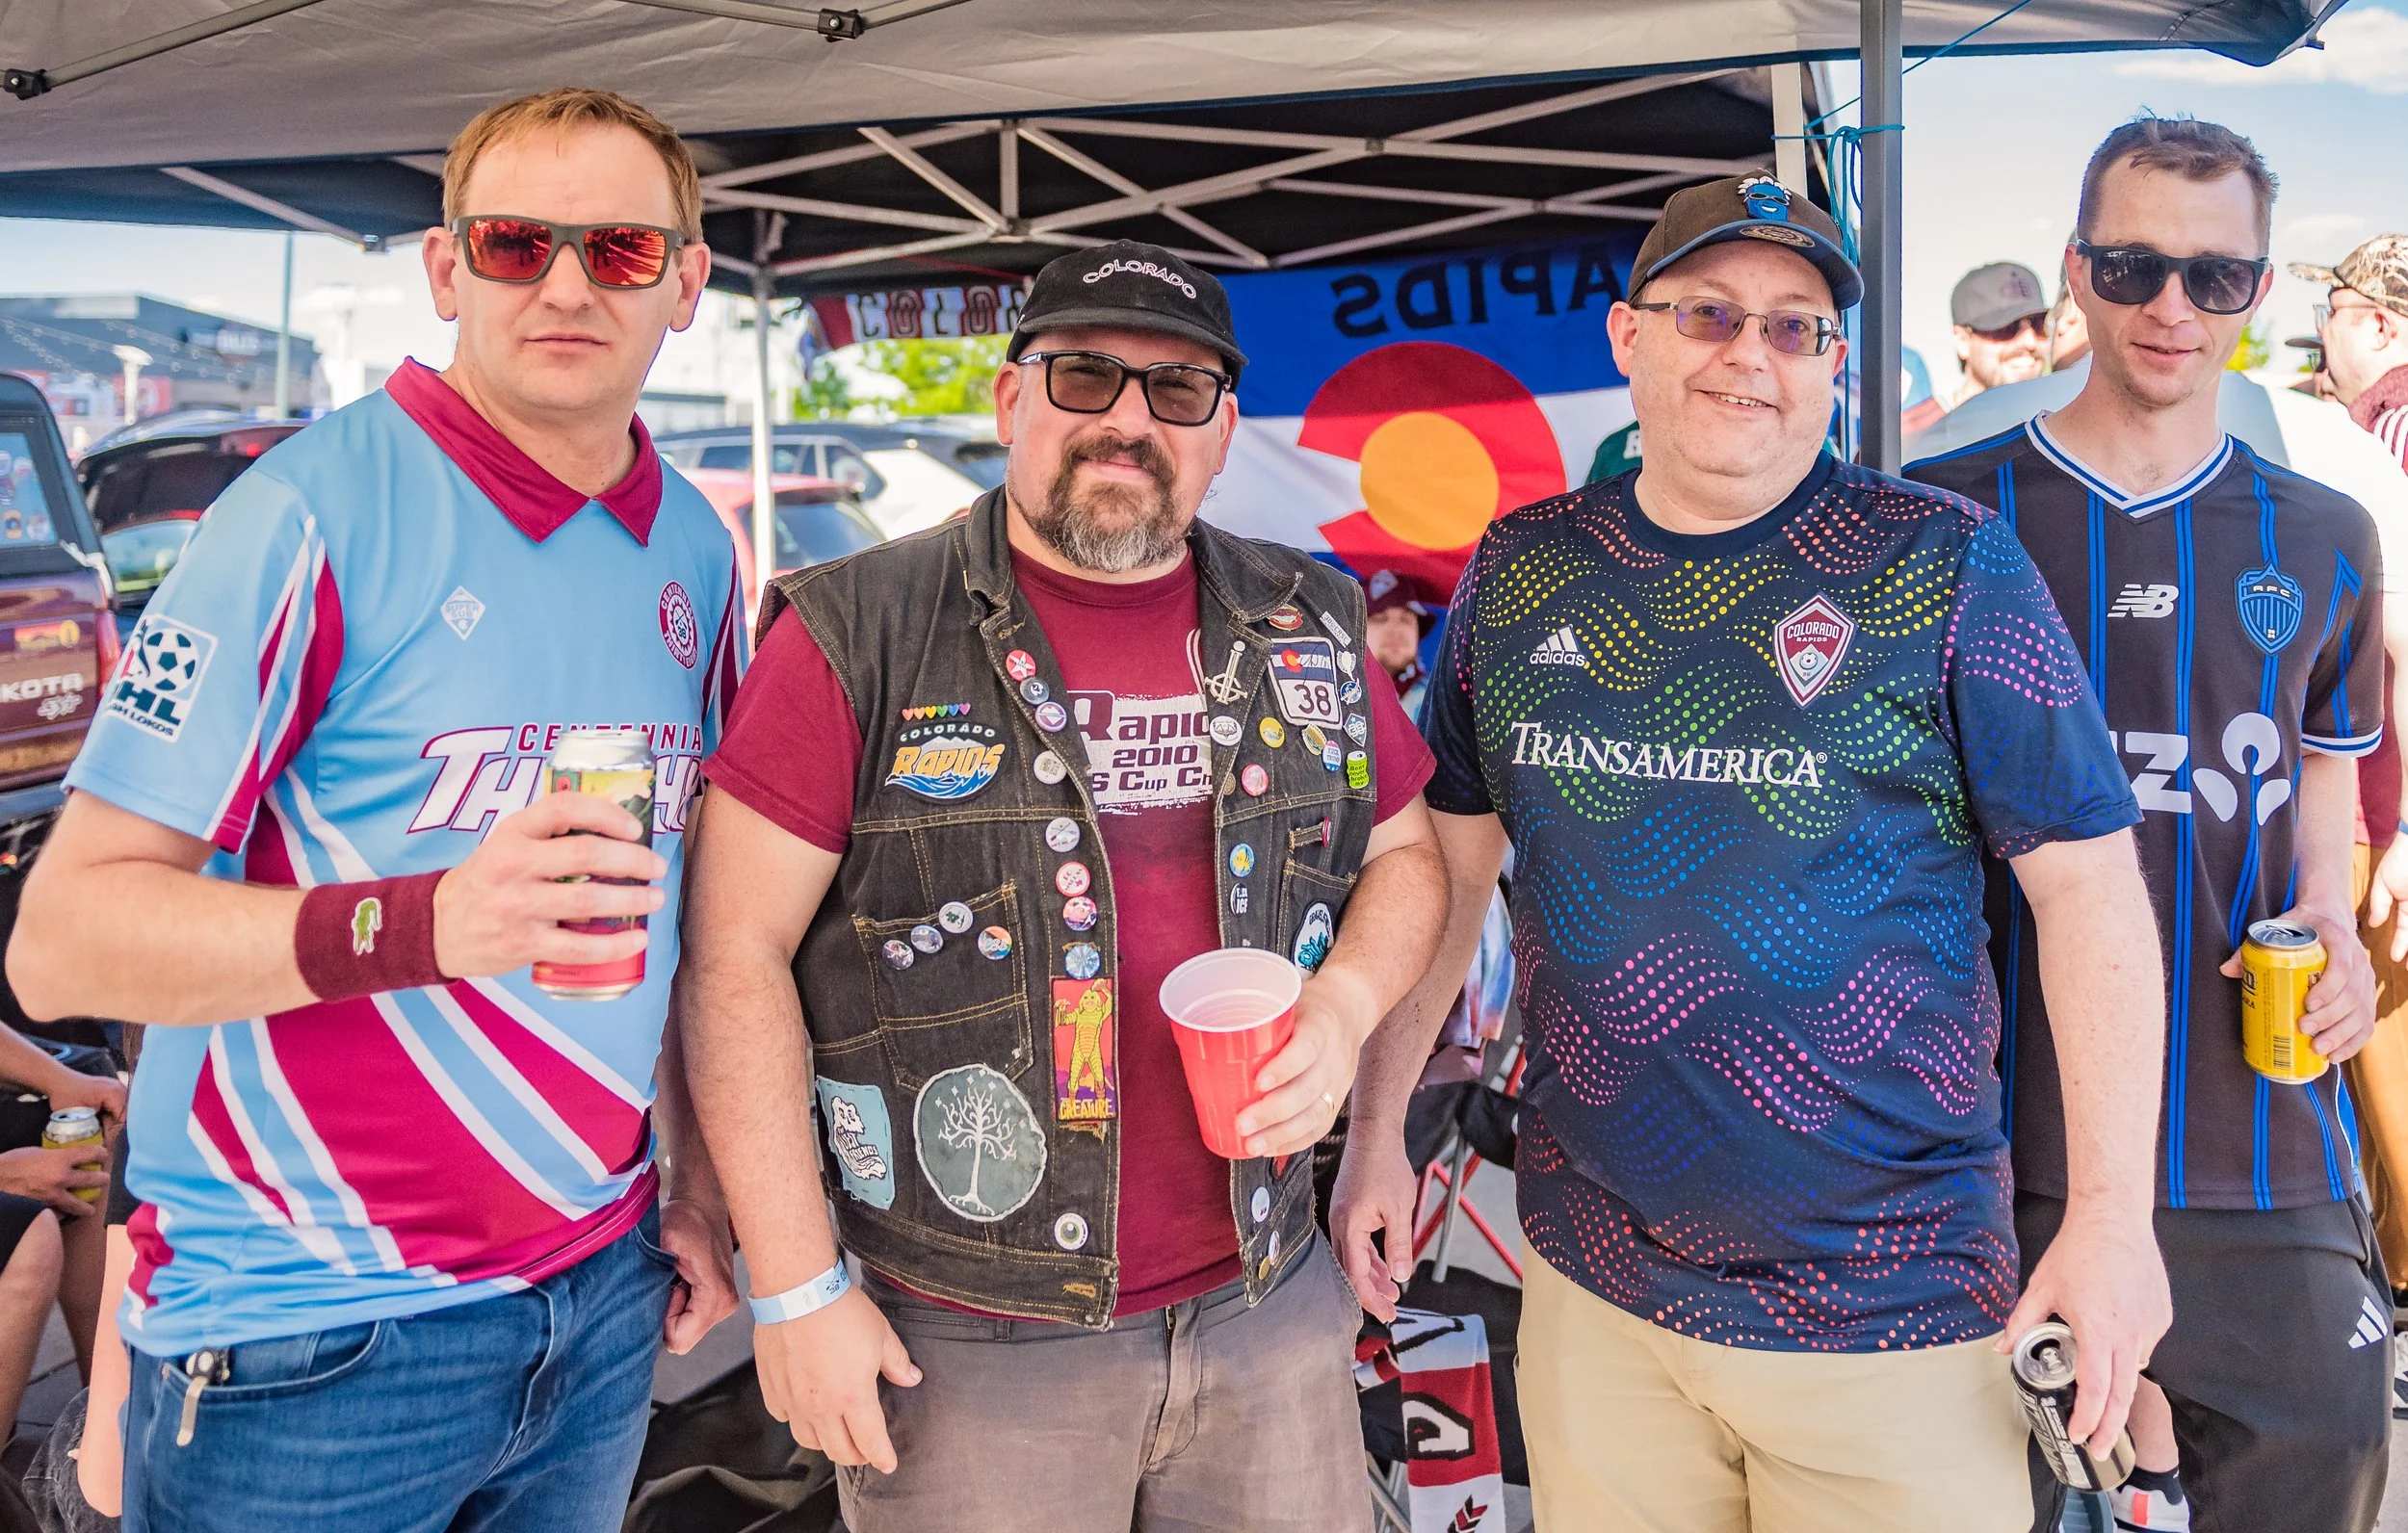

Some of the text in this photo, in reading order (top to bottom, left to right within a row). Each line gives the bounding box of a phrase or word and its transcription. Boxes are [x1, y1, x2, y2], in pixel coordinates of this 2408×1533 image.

[1083, 259, 1197, 299] COLORADO
[1787, 621, 1841, 639] COLORADO
[1529, 649, 1585, 667] adidas
[0, 672, 84, 703] KOTA
[116, 679, 181, 726] HL
[1294, 684, 1332, 715] 38
[900, 723, 996, 741] COLORADO
[891, 743, 1006, 779] RAPIDS
[1112, 744, 1198, 768] 2010
[1118, 770, 1167, 791] Cup
[1060, 1097, 1112, 1120] CREATURE
[849, 1144, 878, 1160] FRIENDS
